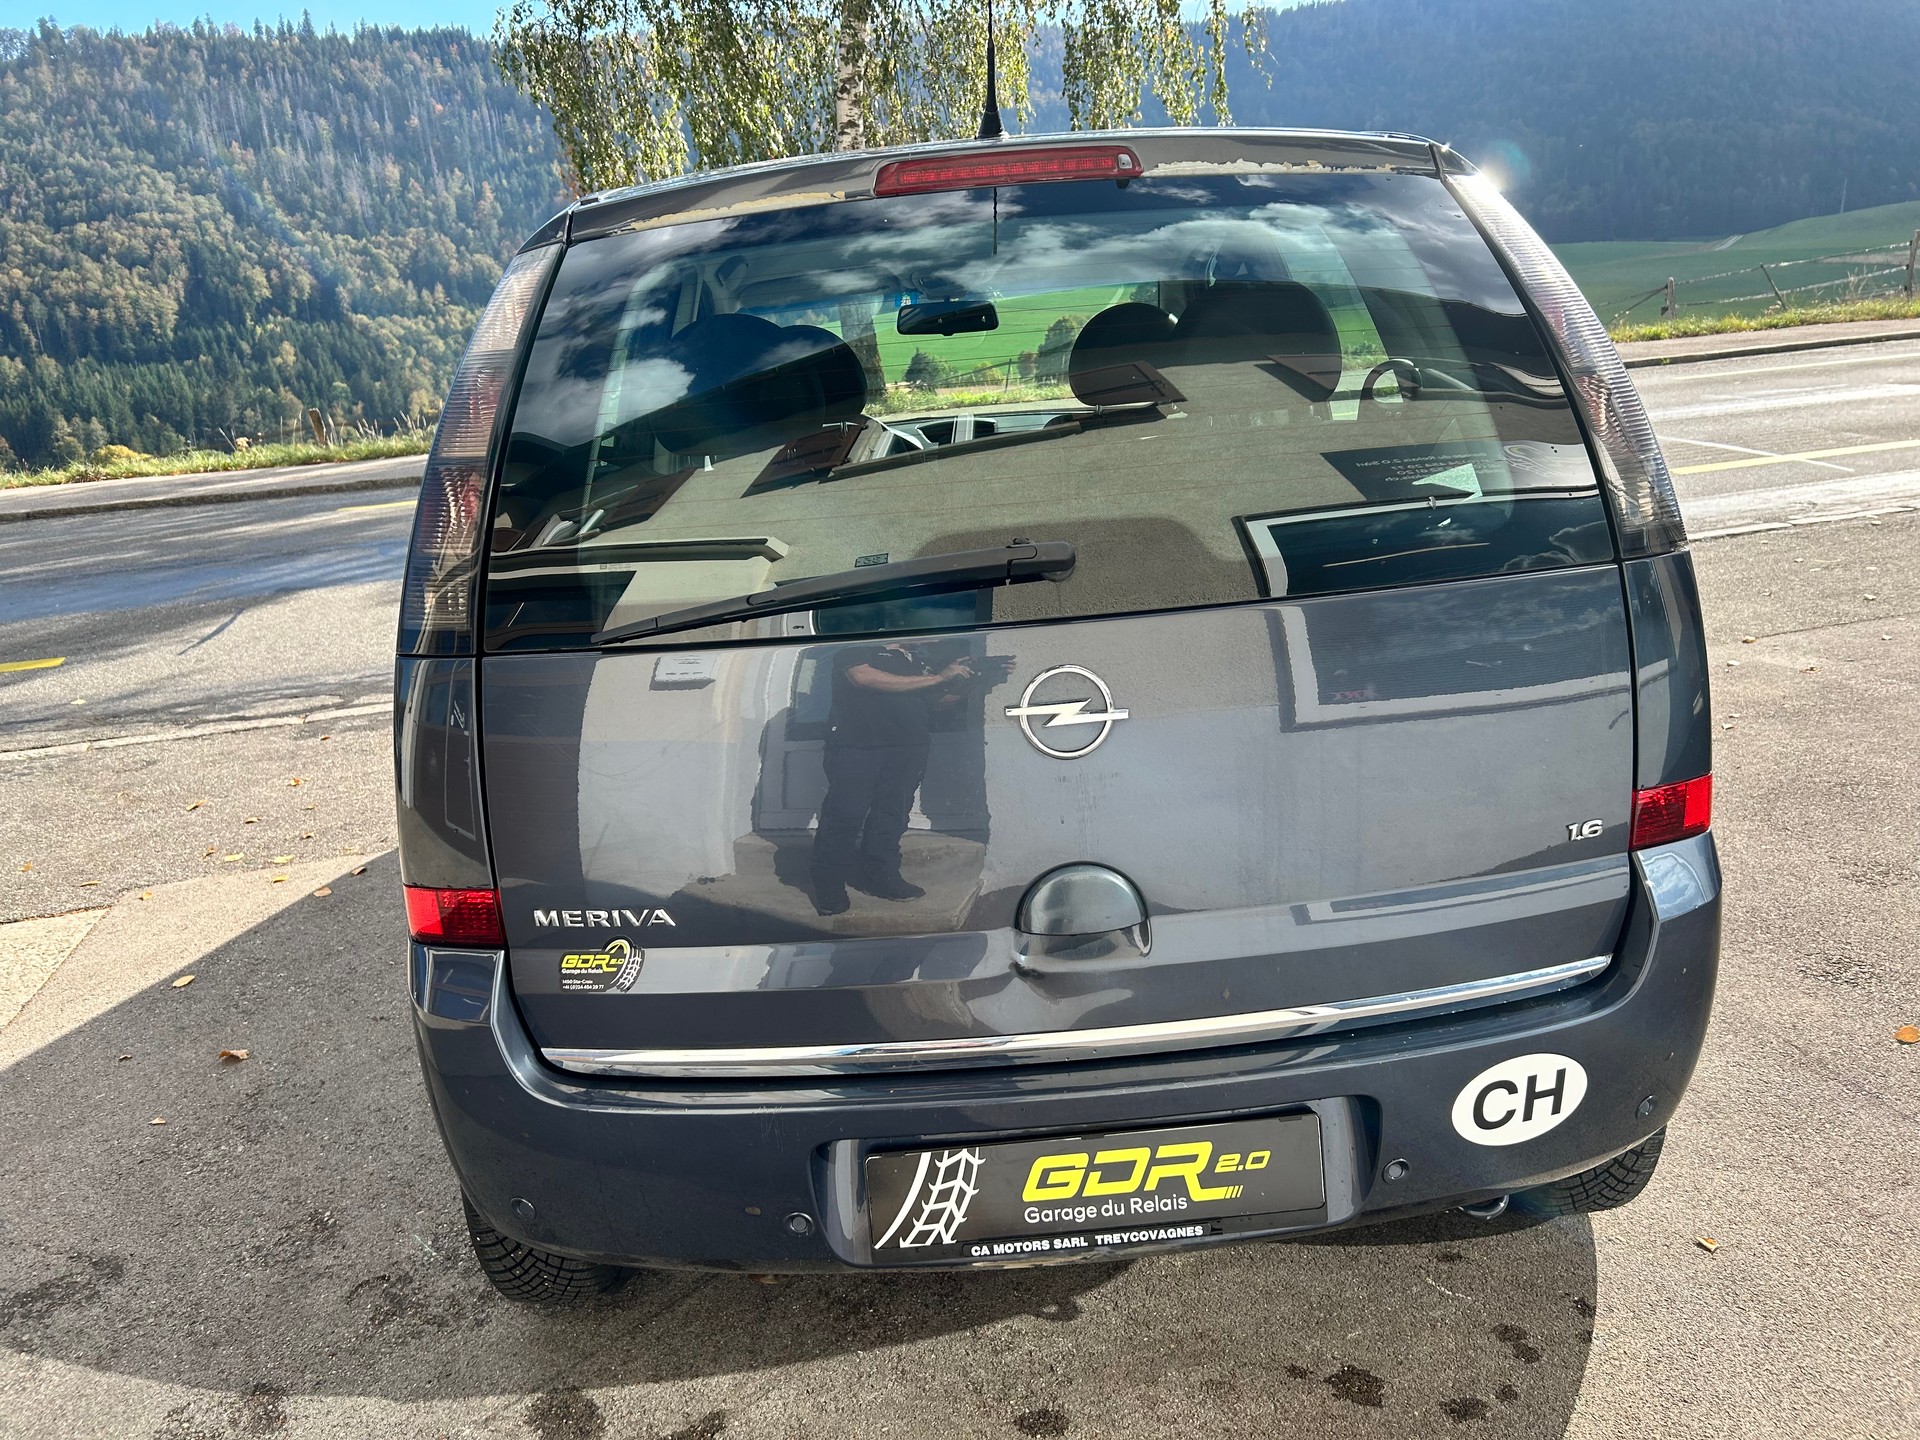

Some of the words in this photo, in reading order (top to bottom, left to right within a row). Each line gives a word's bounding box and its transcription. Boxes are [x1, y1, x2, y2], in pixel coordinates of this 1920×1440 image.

[533, 908, 677, 928] MERIVA
[561, 954, 618, 973] GDR
[1473, 1067, 1567, 1131] CH
[1022, 1141, 1228, 1202] GDR
[1214, 1150, 1271, 1173] 2.0
[1023, 1206, 1098, 1224] Garage
[1100, 1199, 1126, 1217] du
[1130, 1193, 1188, 1214] Relais
[971, 1245, 991, 1257] CA
[993, 1239, 1051, 1255] MOTORS
[1053, 1236, 1089, 1250] SARL
[1094, 1225, 1204, 1246] TREYCOVAGNES
